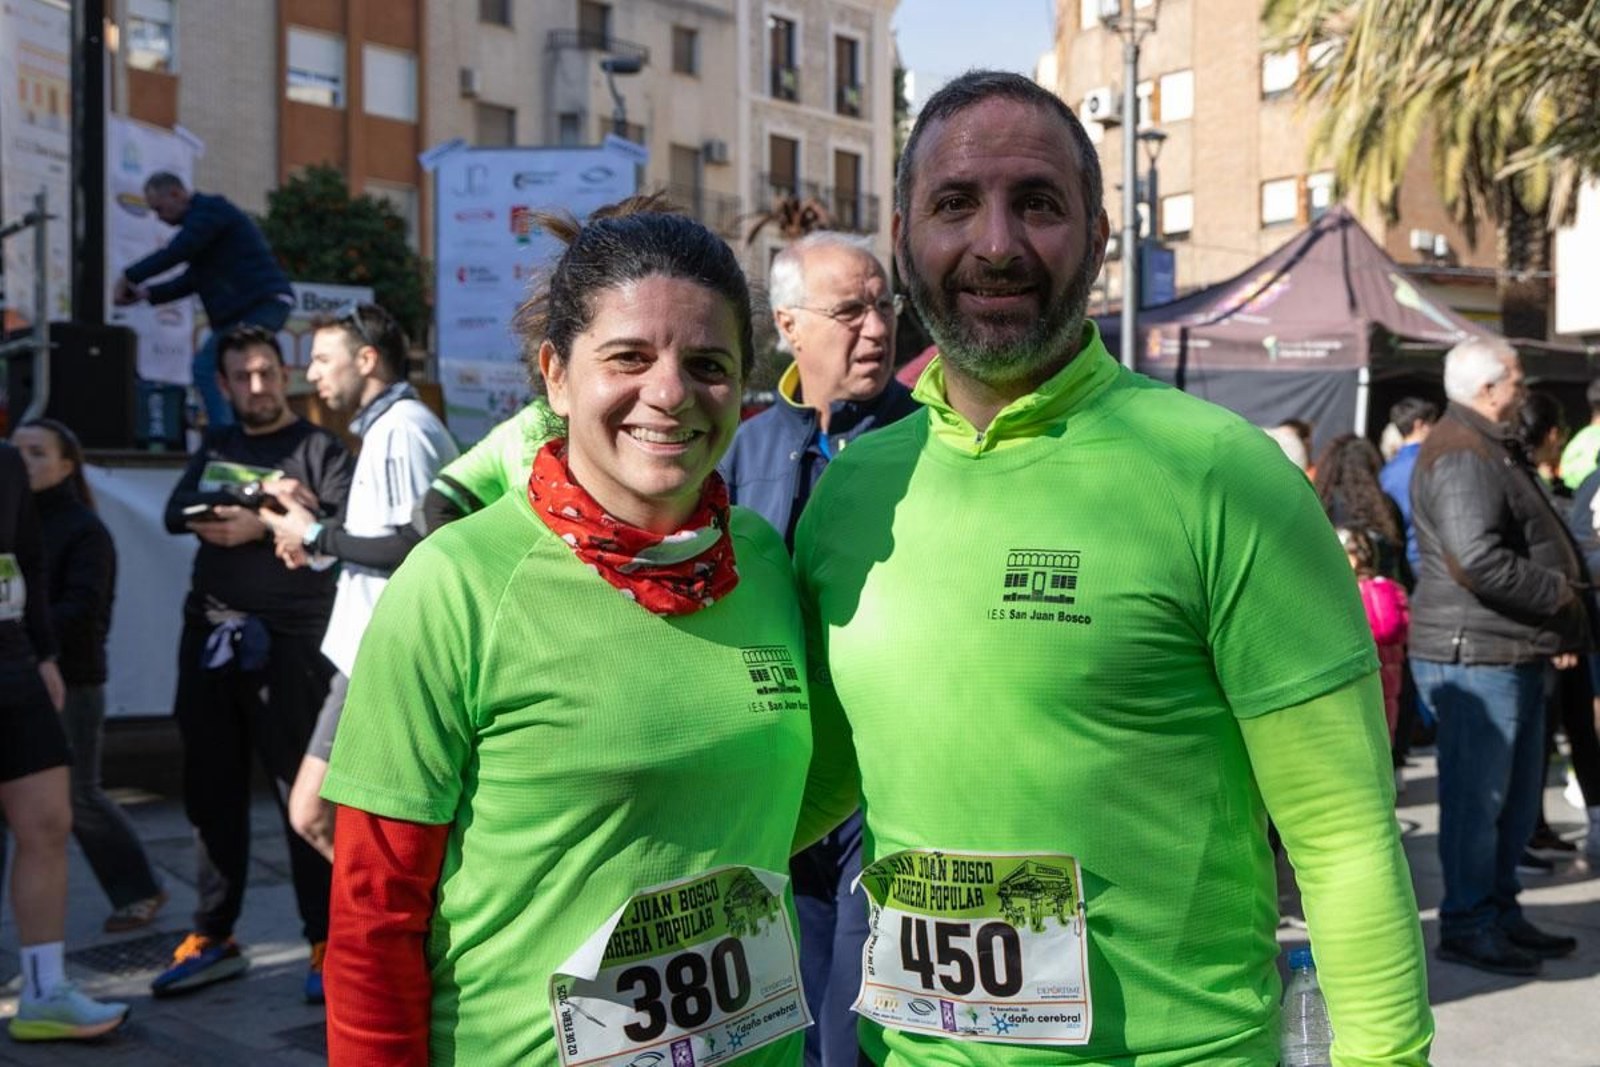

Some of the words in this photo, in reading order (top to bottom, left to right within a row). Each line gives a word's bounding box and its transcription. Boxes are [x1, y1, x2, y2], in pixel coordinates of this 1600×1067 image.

[1009, 609, 1027, 620] San
[1030, 610, 1054, 621] Juan
[1058, 611, 1092, 625] Bosco
[768, 701, 783, 711] San
[890, 855, 915, 877] SAN
[918, 856, 947, 882] JUAN
[952, 860, 994, 884] BOSCO
[631, 893, 674, 926] JUAN
[678, 878, 719, 913] BOSCO
[892, 876, 928, 910] CARRERA
[930, 885, 985, 911] POPULAR
[655, 907, 715, 950] POPULAR
[900, 915, 1024, 998] 450
[615, 937, 752, 1043] 380
[740, 1018, 762, 1033] daño
[763, 1000, 797, 1023] cerebral
[1008, 1013, 1035, 1023] daño
[1037, 1013, 1081, 1023] cerebral
[565, 1032, 577, 1044] DE
[567, 1043, 578, 1056] 02
